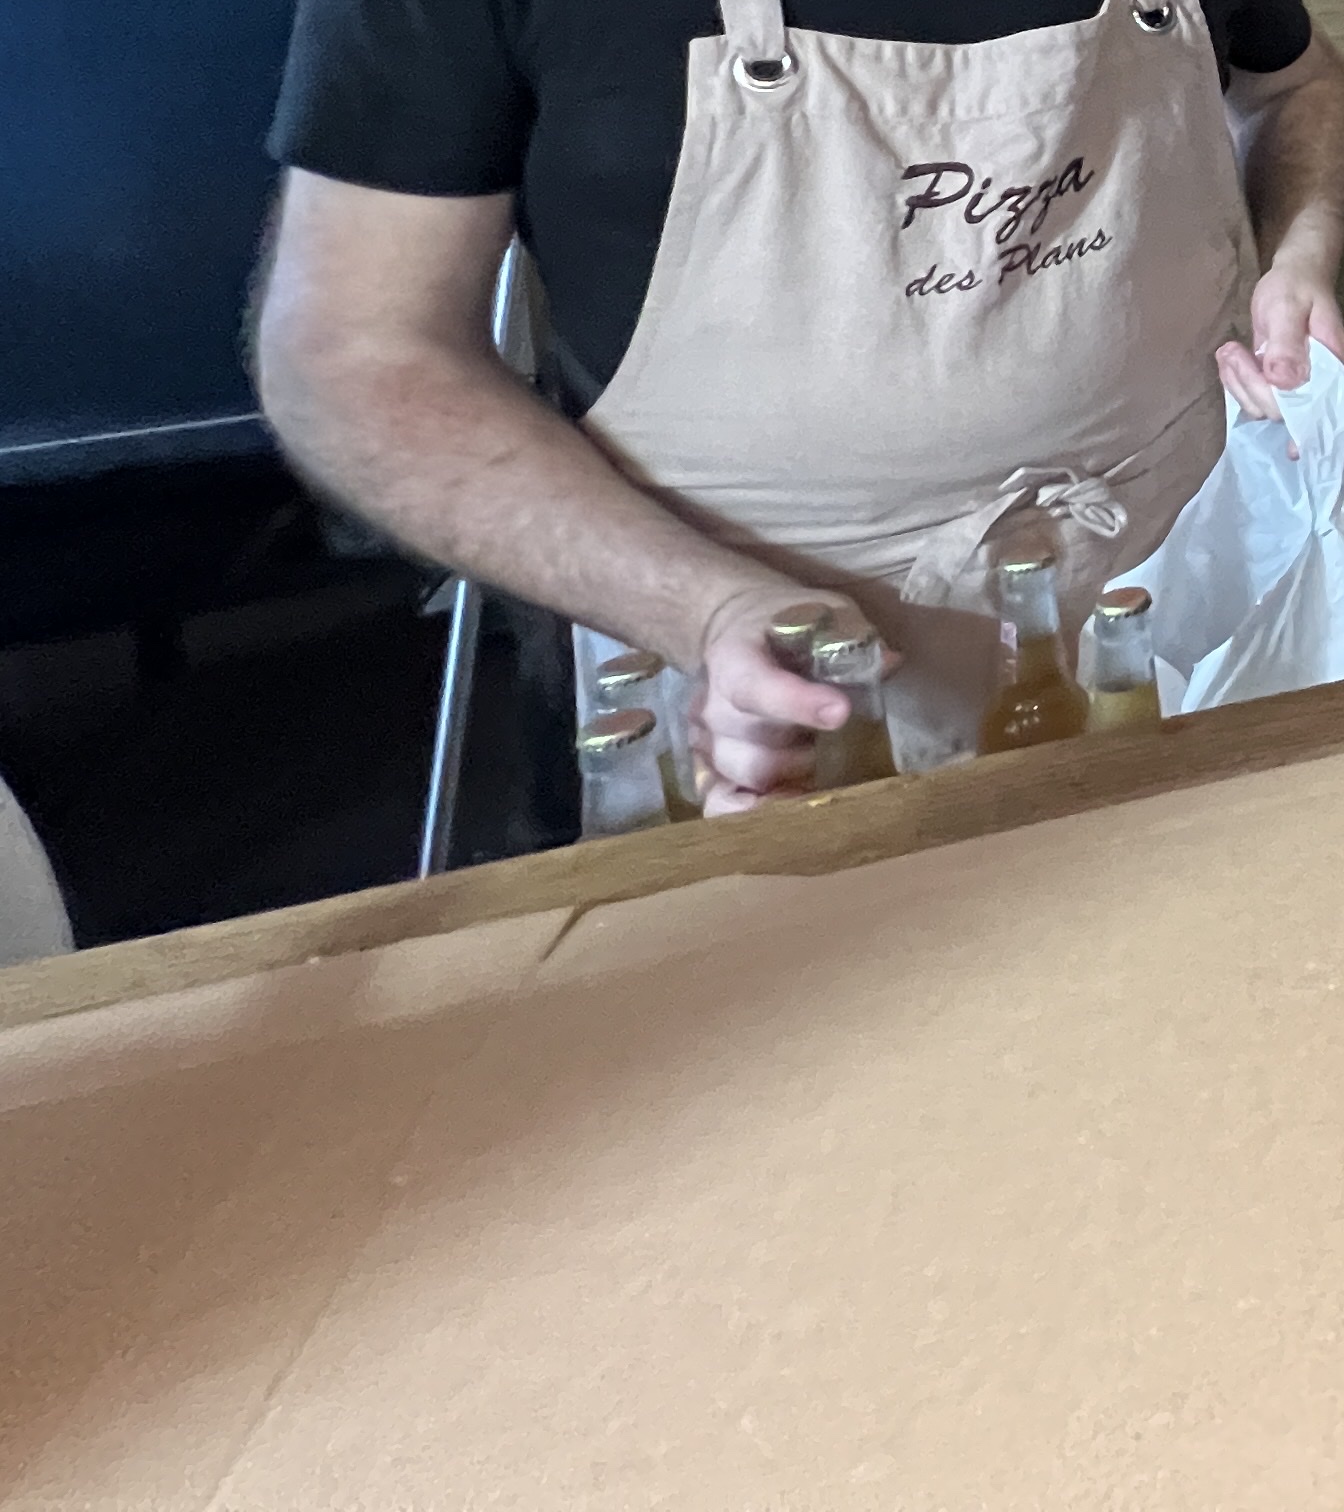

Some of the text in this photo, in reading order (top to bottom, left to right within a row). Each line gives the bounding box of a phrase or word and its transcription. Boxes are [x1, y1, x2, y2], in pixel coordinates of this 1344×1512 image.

[901, 157, 1095, 244] Pizza
[904, 228, 1112, 298] des Plans
